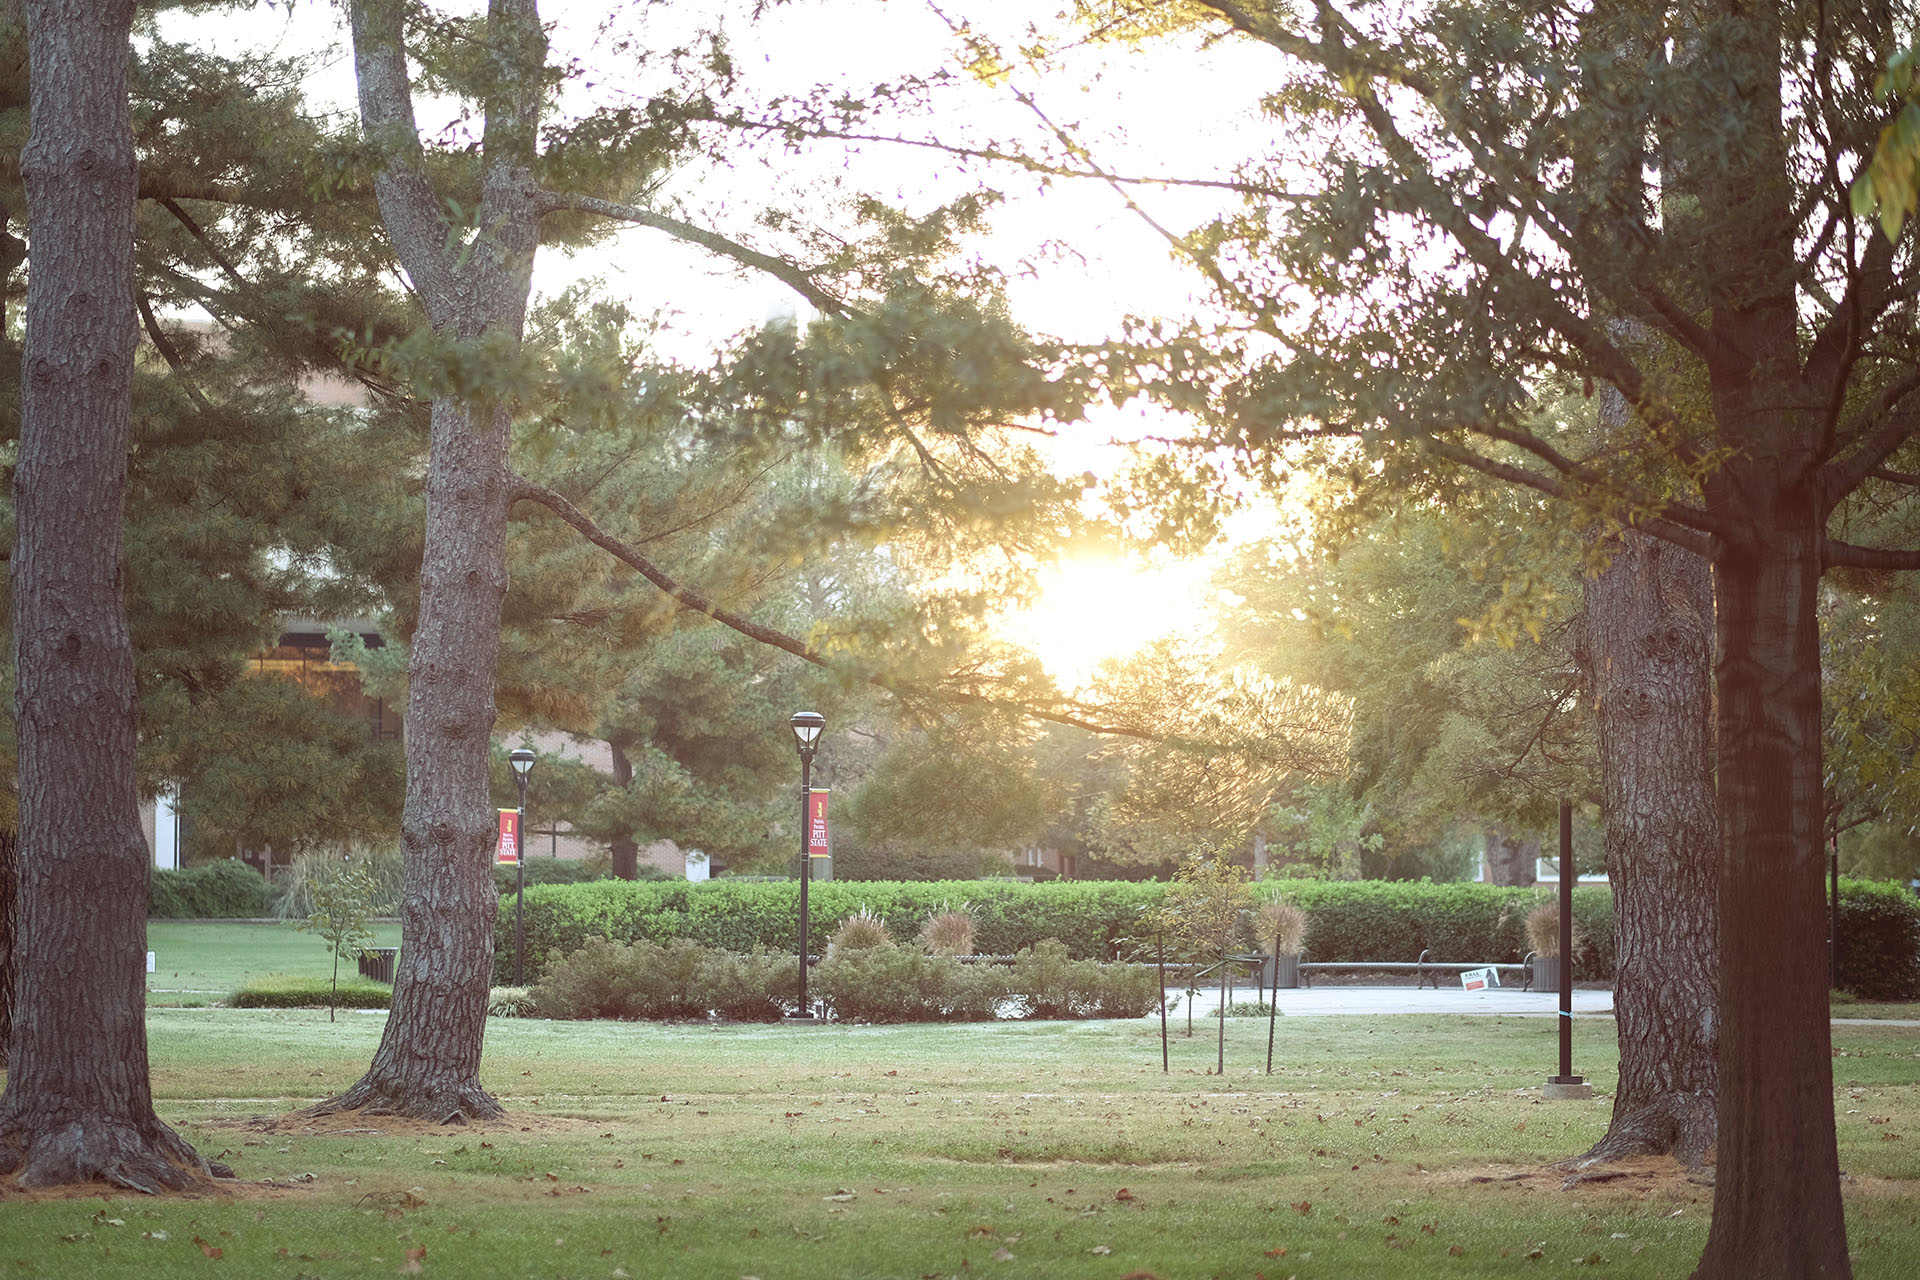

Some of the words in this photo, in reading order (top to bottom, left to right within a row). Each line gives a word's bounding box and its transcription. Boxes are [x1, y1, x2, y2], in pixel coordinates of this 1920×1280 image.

[812, 830, 826, 838] PITT
[810, 838, 827, 847] STATE
[499, 848, 516, 856] STATE
